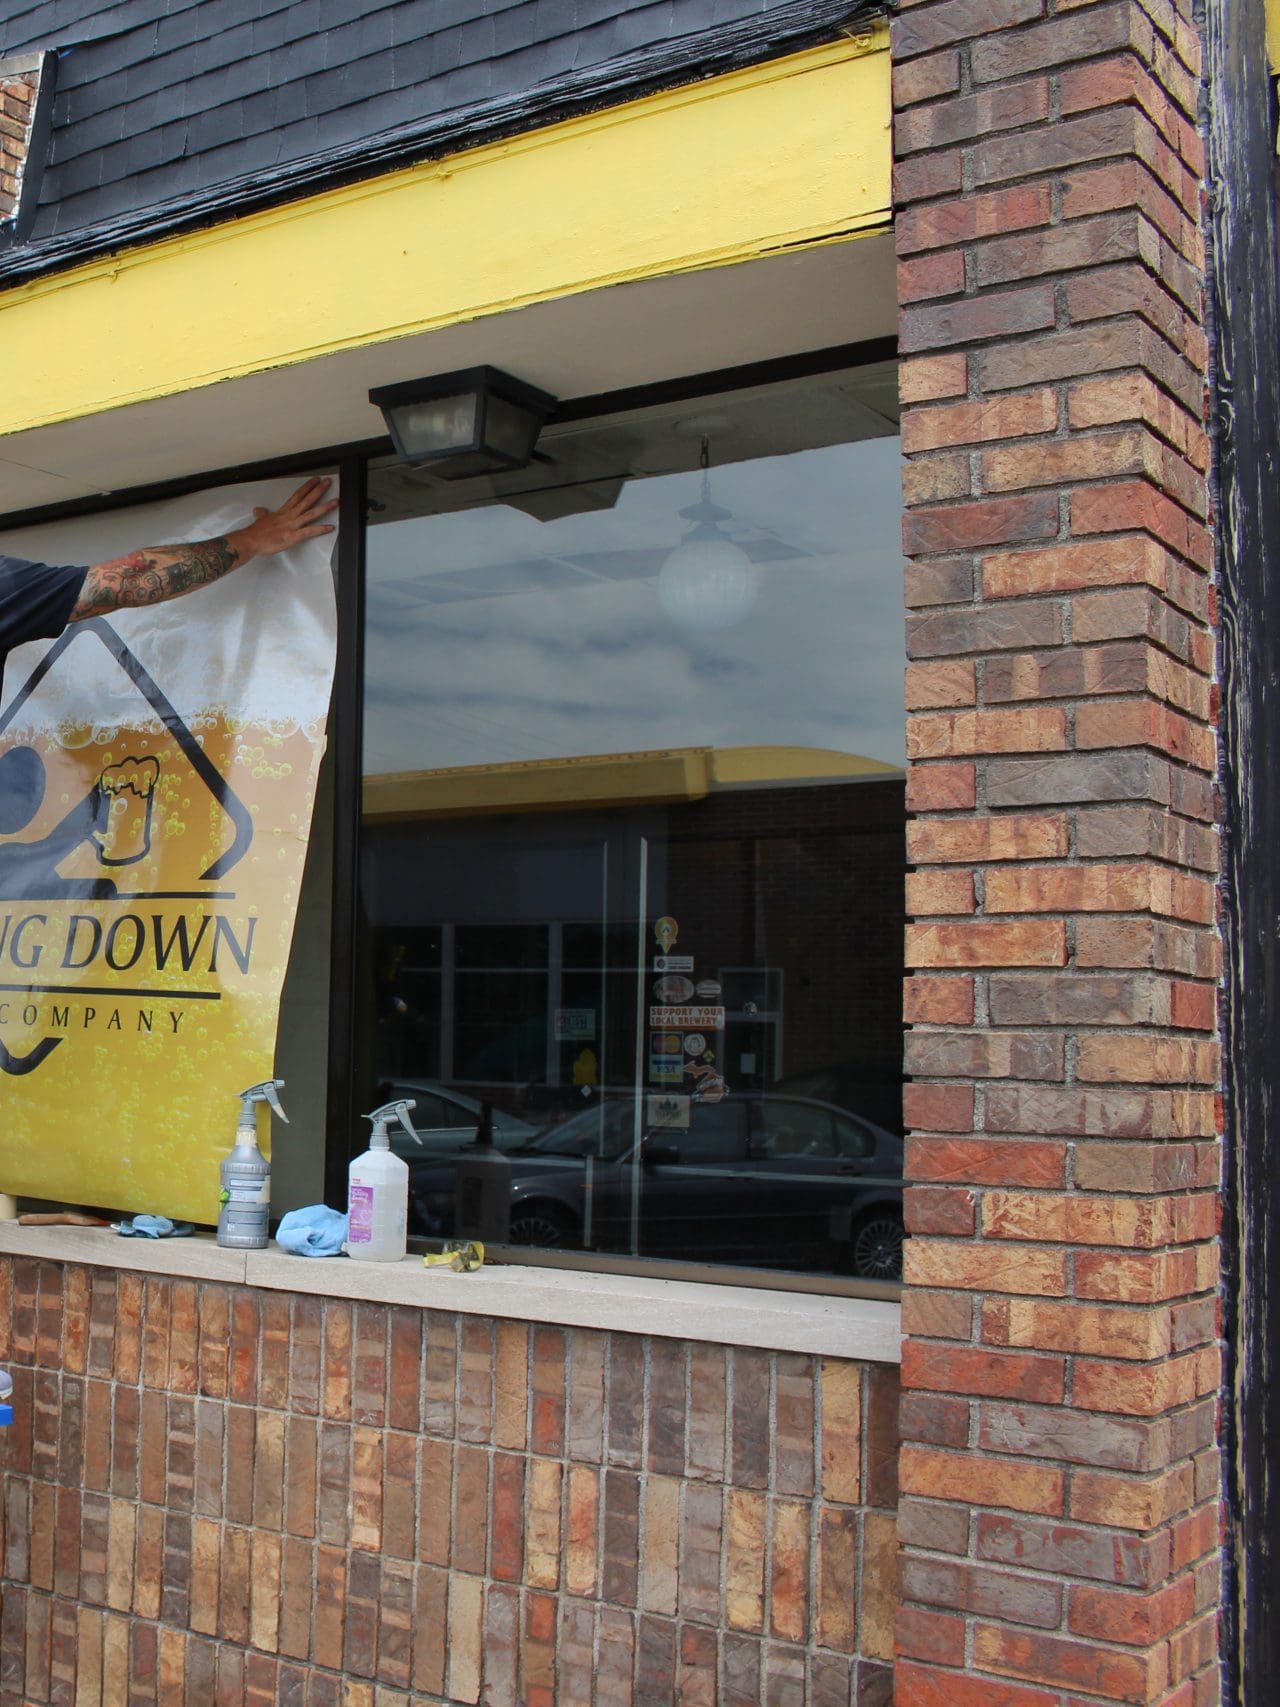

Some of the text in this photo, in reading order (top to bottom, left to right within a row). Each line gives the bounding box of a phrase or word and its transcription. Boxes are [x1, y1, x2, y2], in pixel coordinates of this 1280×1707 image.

[60, 914, 258, 975] DOWN
[651, 1007, 724, 1017] SUPPORT YOUR
[651, 1016, 717, 1025] LOCAL BREWERY
